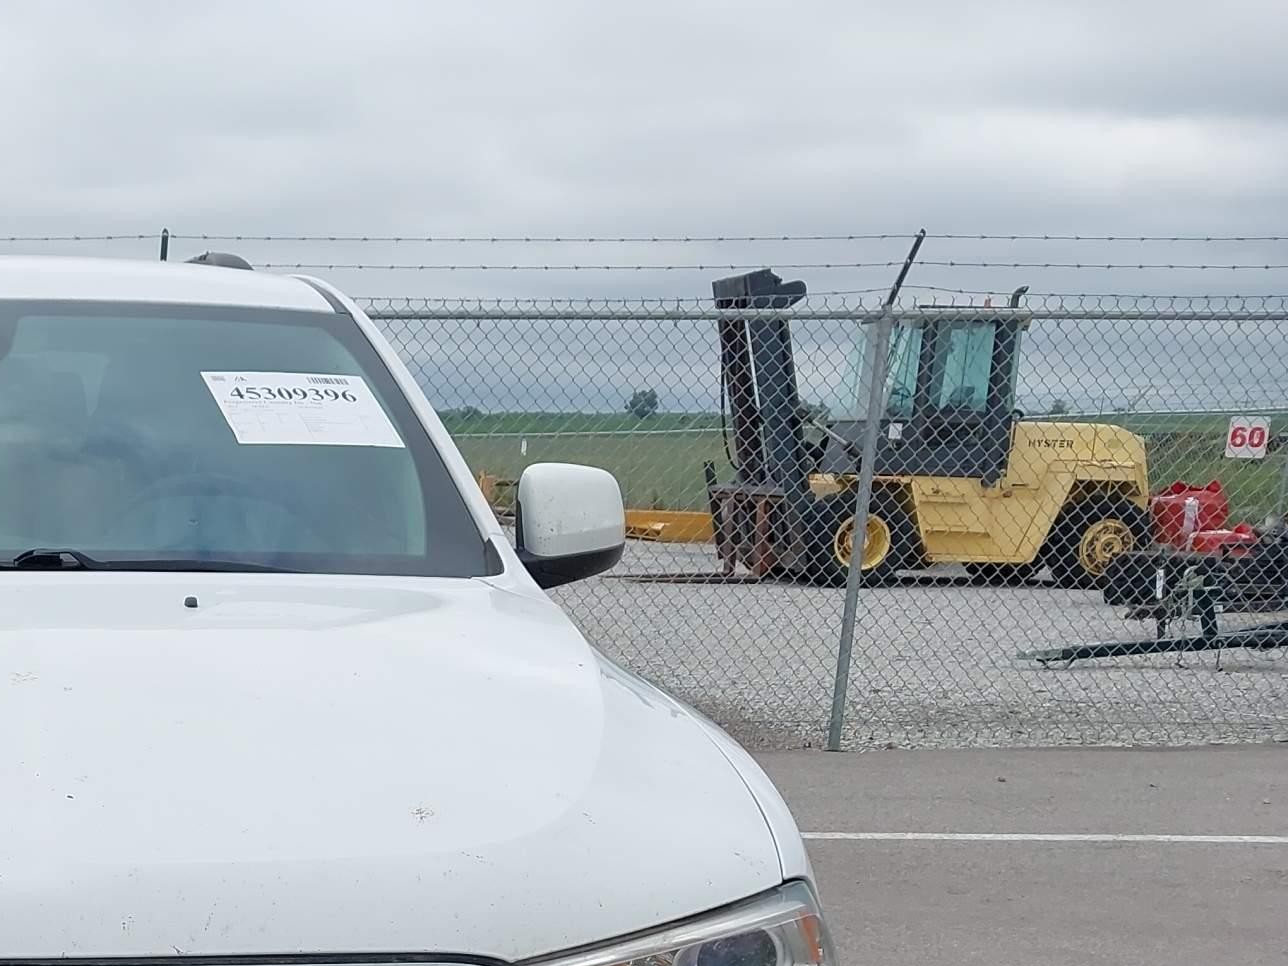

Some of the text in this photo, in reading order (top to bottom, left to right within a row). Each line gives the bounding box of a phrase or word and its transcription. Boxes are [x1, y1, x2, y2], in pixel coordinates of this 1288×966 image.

[230, 386, 357, 404] 45309396
[1028, 439, 1074, 448] HYSTER
[1230, 426, 1266, 448] 60
